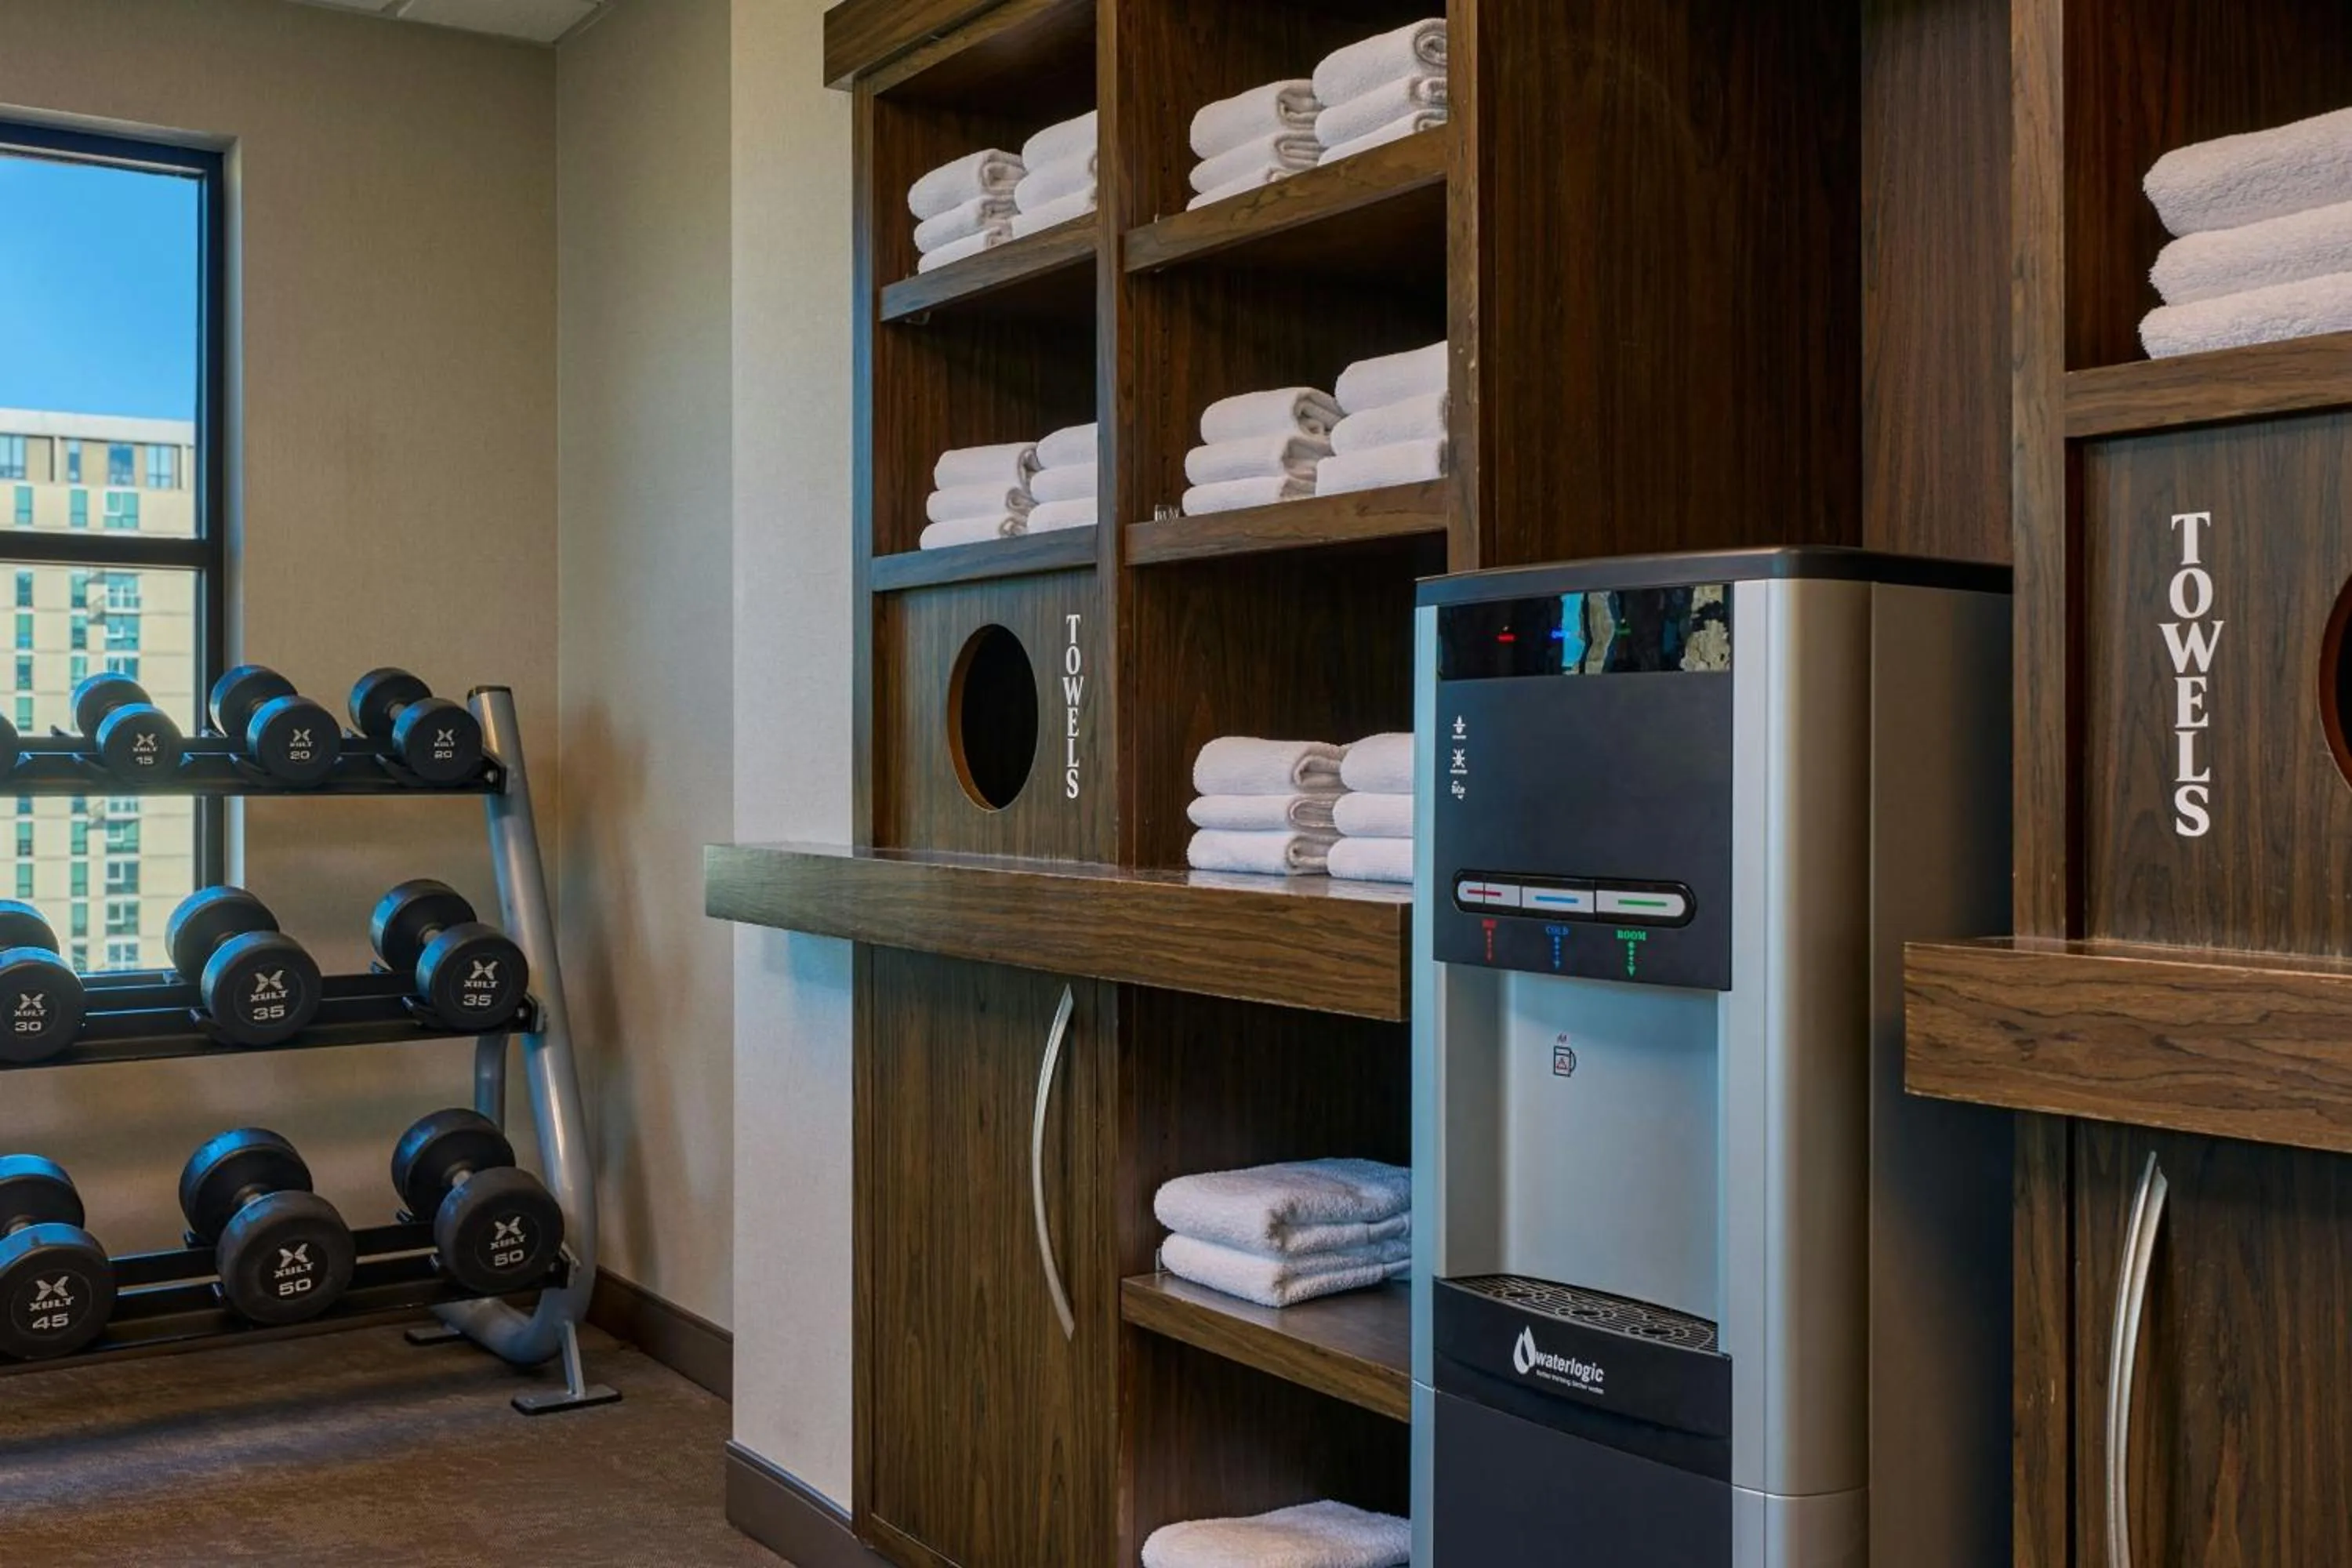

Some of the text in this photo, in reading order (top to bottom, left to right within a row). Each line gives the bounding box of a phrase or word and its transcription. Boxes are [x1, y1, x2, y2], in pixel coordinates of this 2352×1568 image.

[2158, 512, 2224, 837] TOWELS
[1062, 614, 1084, 799] TOWELS
[463, 994, 492, 1006] 35
[252, 1004, 285, 1020] 35
[15, 1022, 42, 1031] 30
[495, 1250, 524, 1266] 50
[278, 1279, 311, 1296] 50
[32, 1313, 69, 1330] 45
[1535, 1351, 1604, 1383] waterlogic
